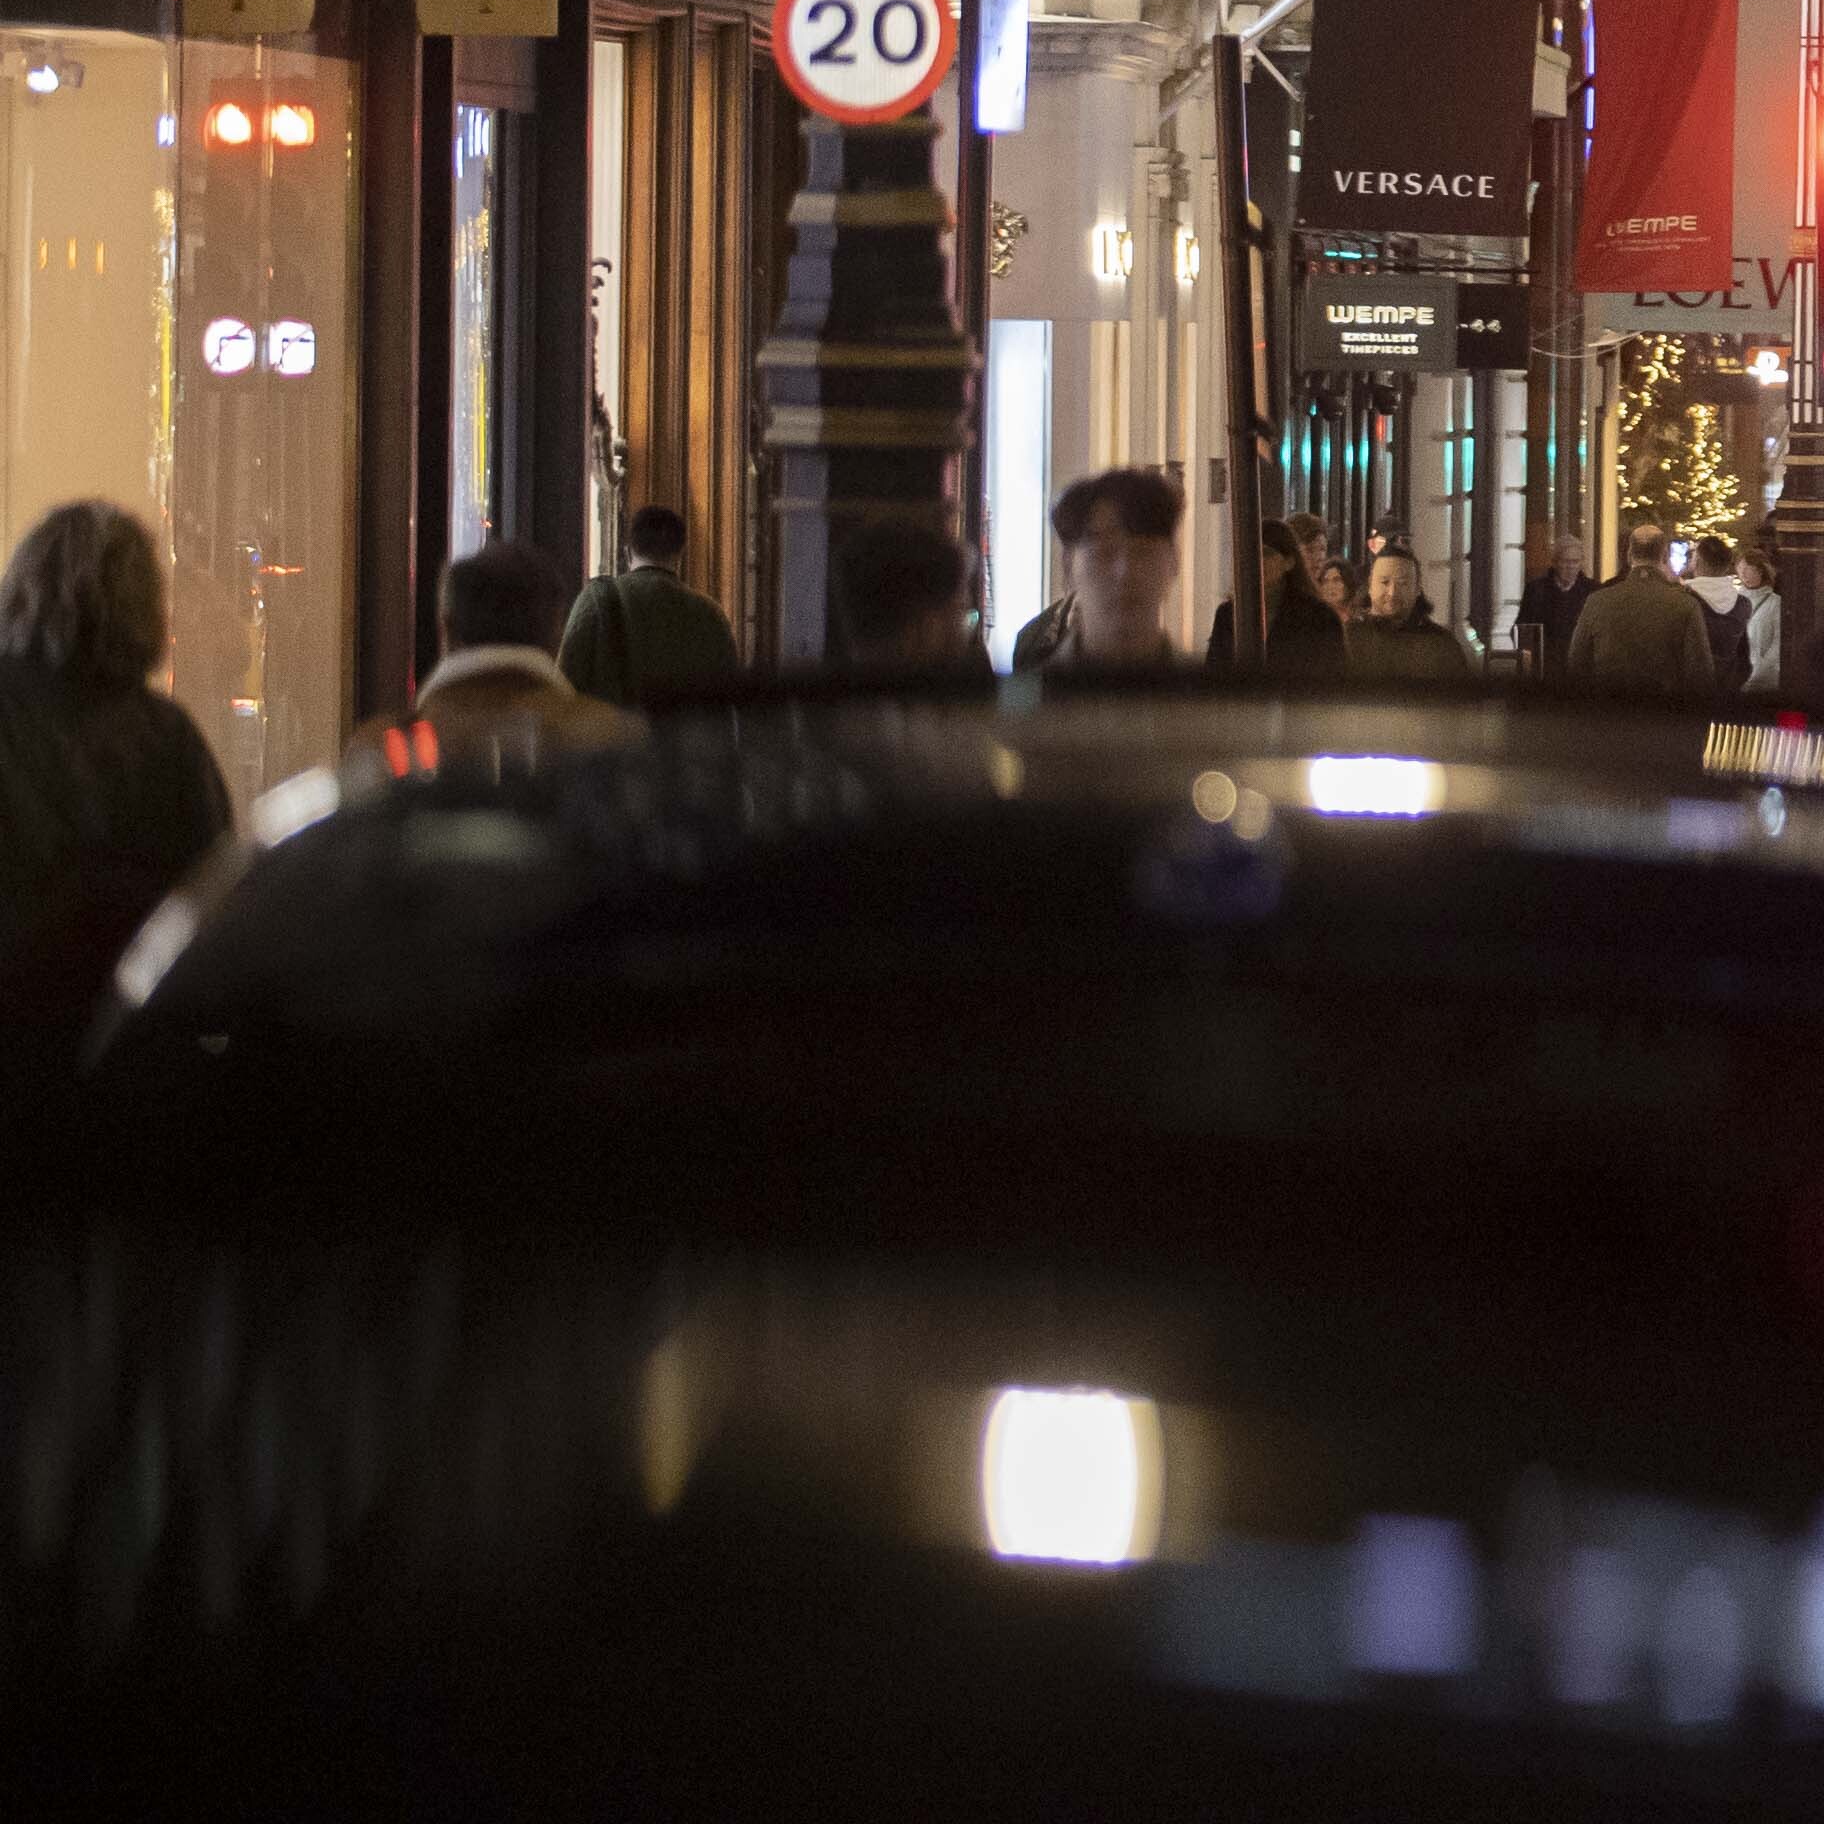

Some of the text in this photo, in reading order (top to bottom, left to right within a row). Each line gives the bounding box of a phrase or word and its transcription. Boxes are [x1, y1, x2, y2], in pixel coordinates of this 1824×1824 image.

[1334, 171, 1495, 198] VERSACE
[1326, 305, 1435, 325] WEMPE
[1340, 331, 1419, 344] EXCELLENT
[1340, 343, 1420, 355] TIMEPIECES
